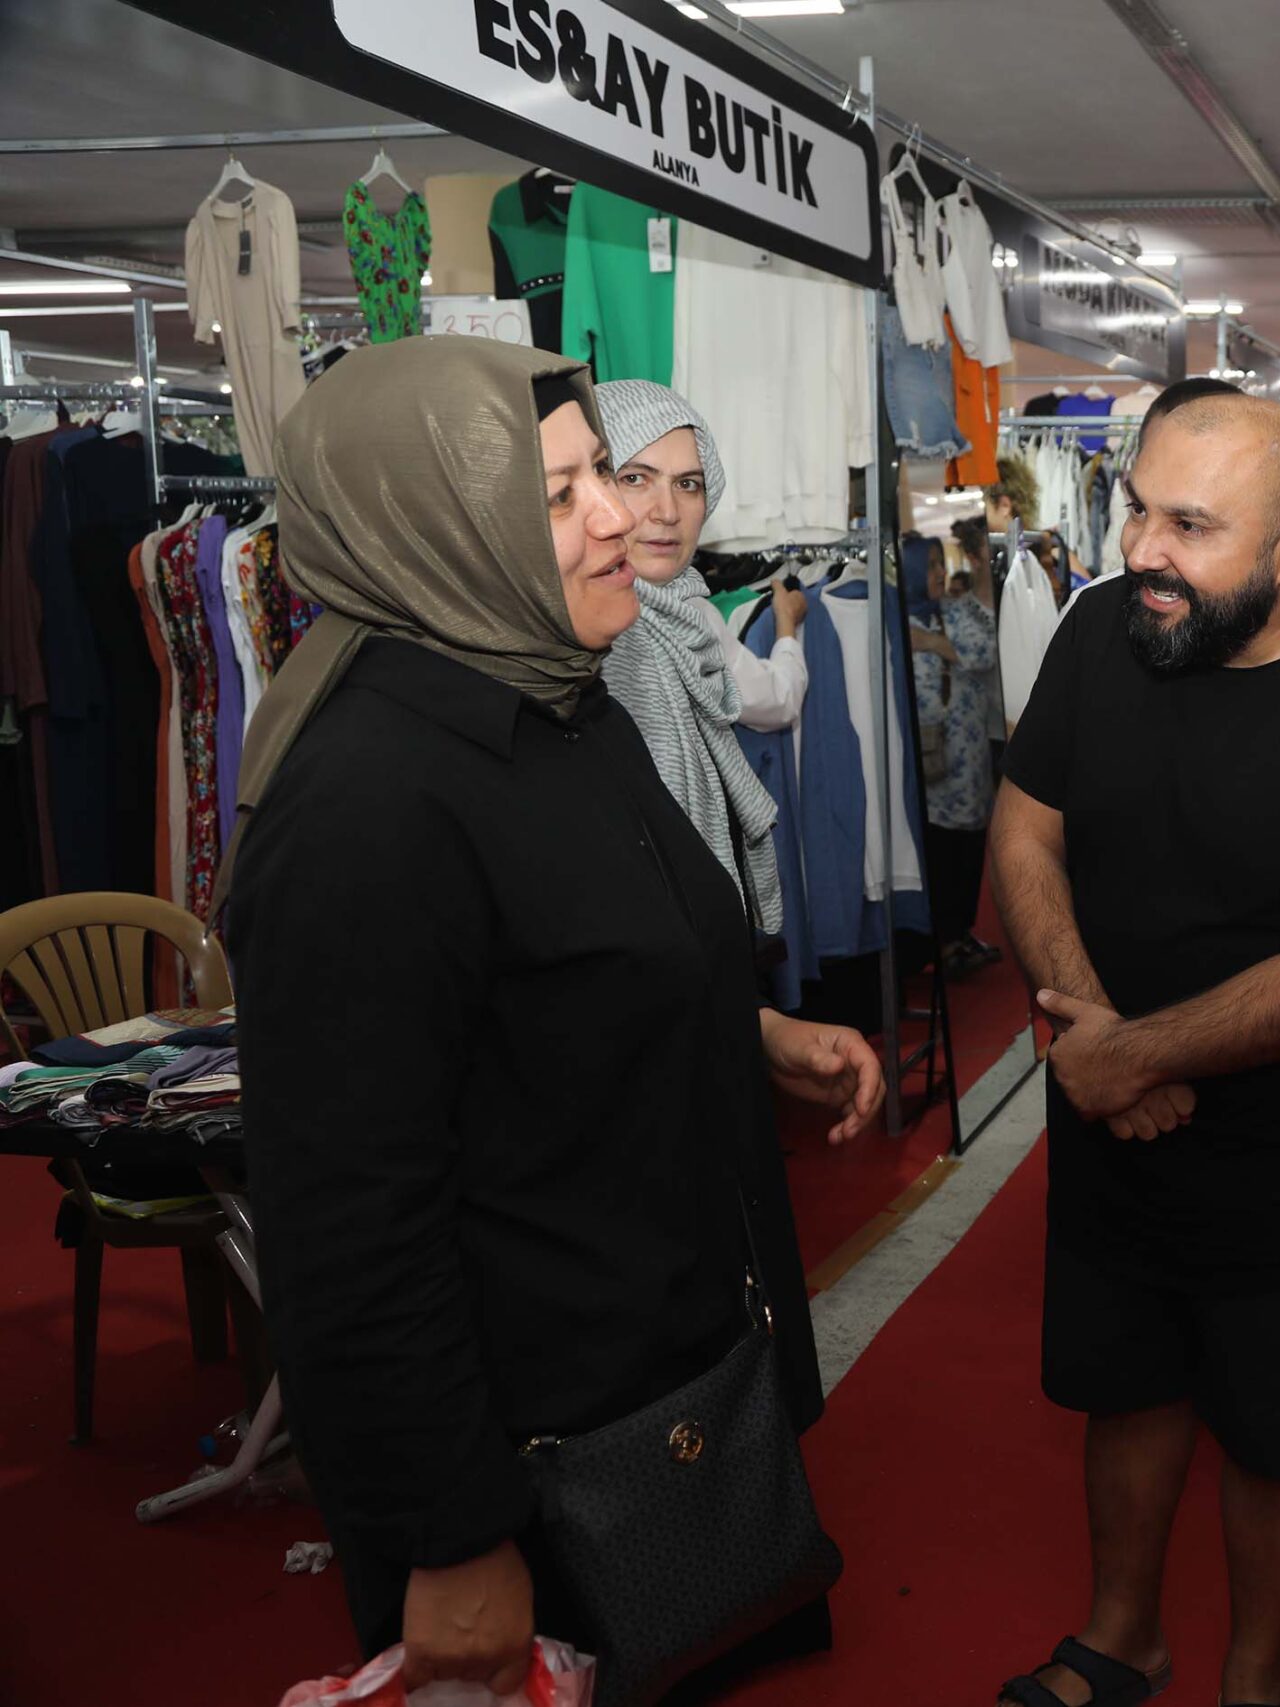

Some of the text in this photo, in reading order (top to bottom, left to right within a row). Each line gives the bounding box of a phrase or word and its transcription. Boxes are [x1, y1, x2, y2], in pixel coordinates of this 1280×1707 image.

[474, 0, 818, 209] ES&AY BUTİK
[652, 149, 700, 187] ALANYA
